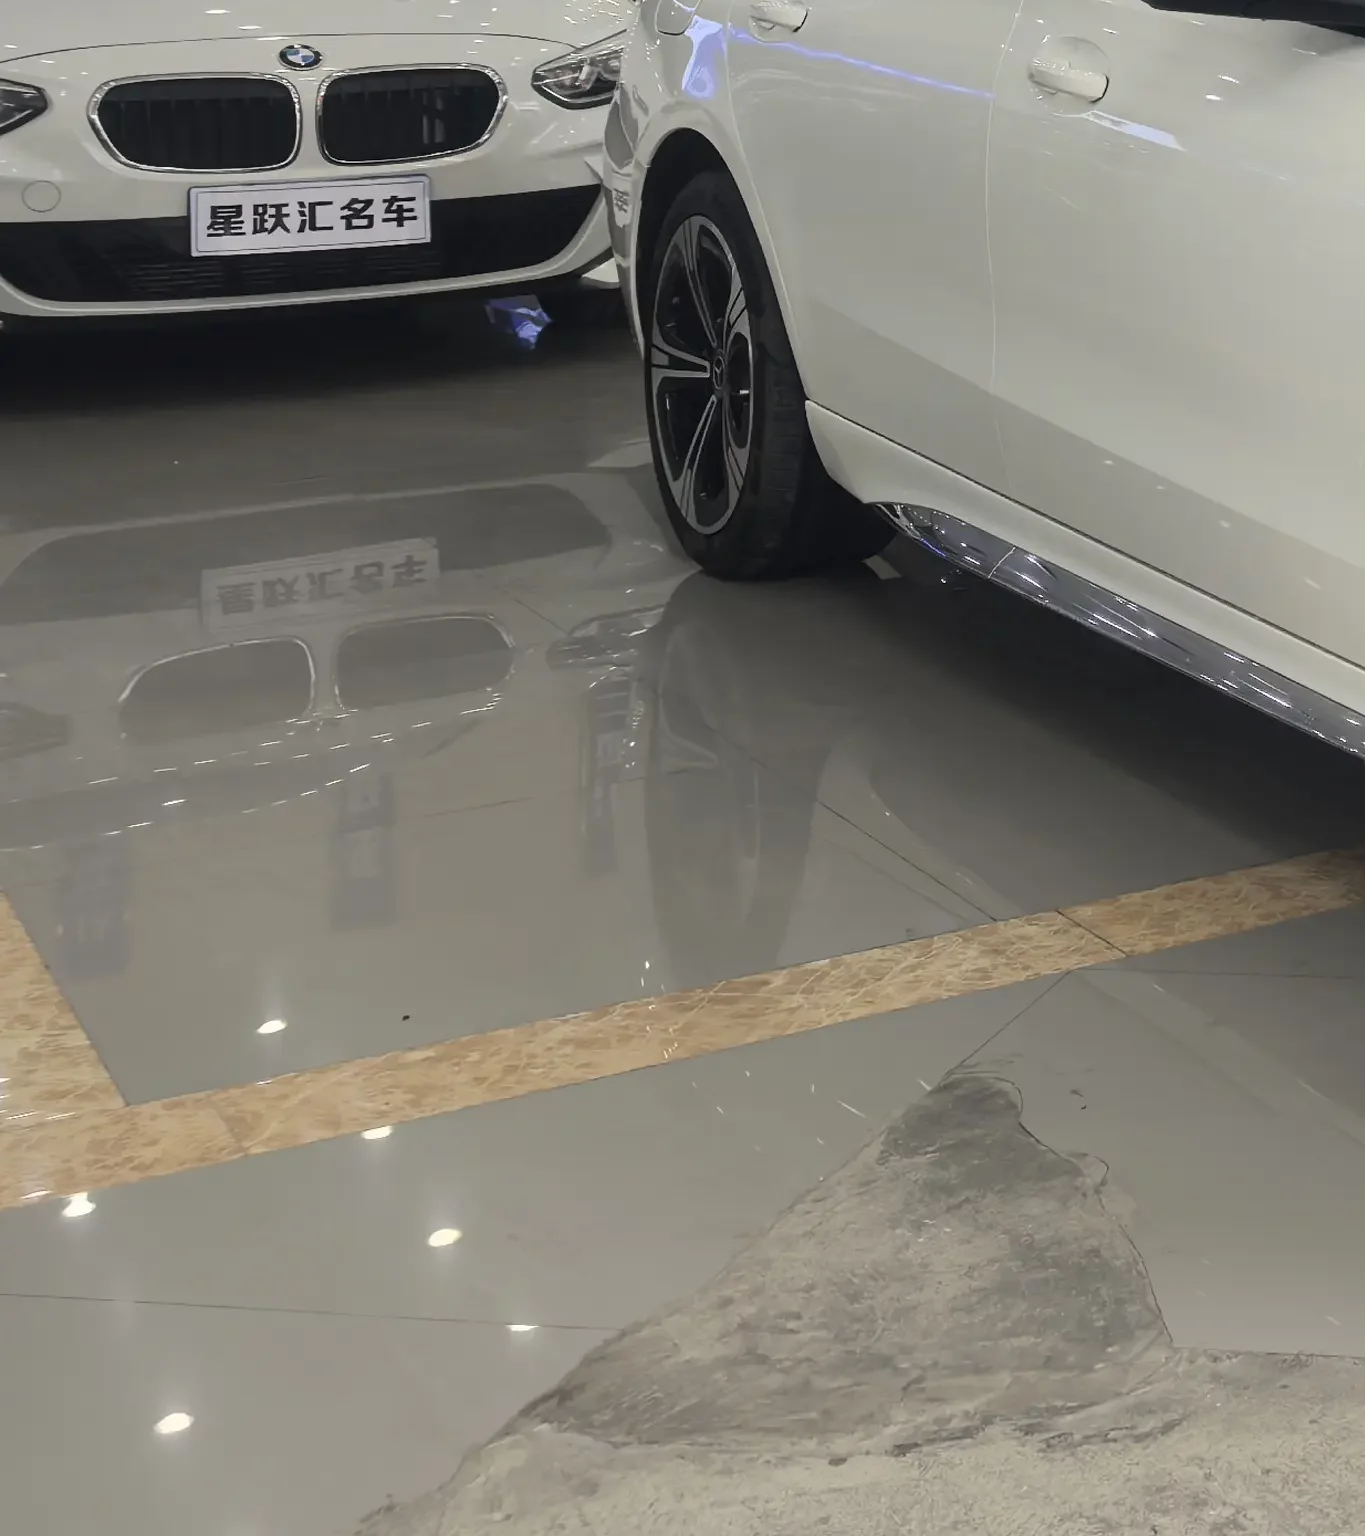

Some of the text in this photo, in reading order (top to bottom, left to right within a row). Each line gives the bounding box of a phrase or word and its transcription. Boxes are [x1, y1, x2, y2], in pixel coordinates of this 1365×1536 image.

[205, 195, 418, 238] 星跃汇名车
